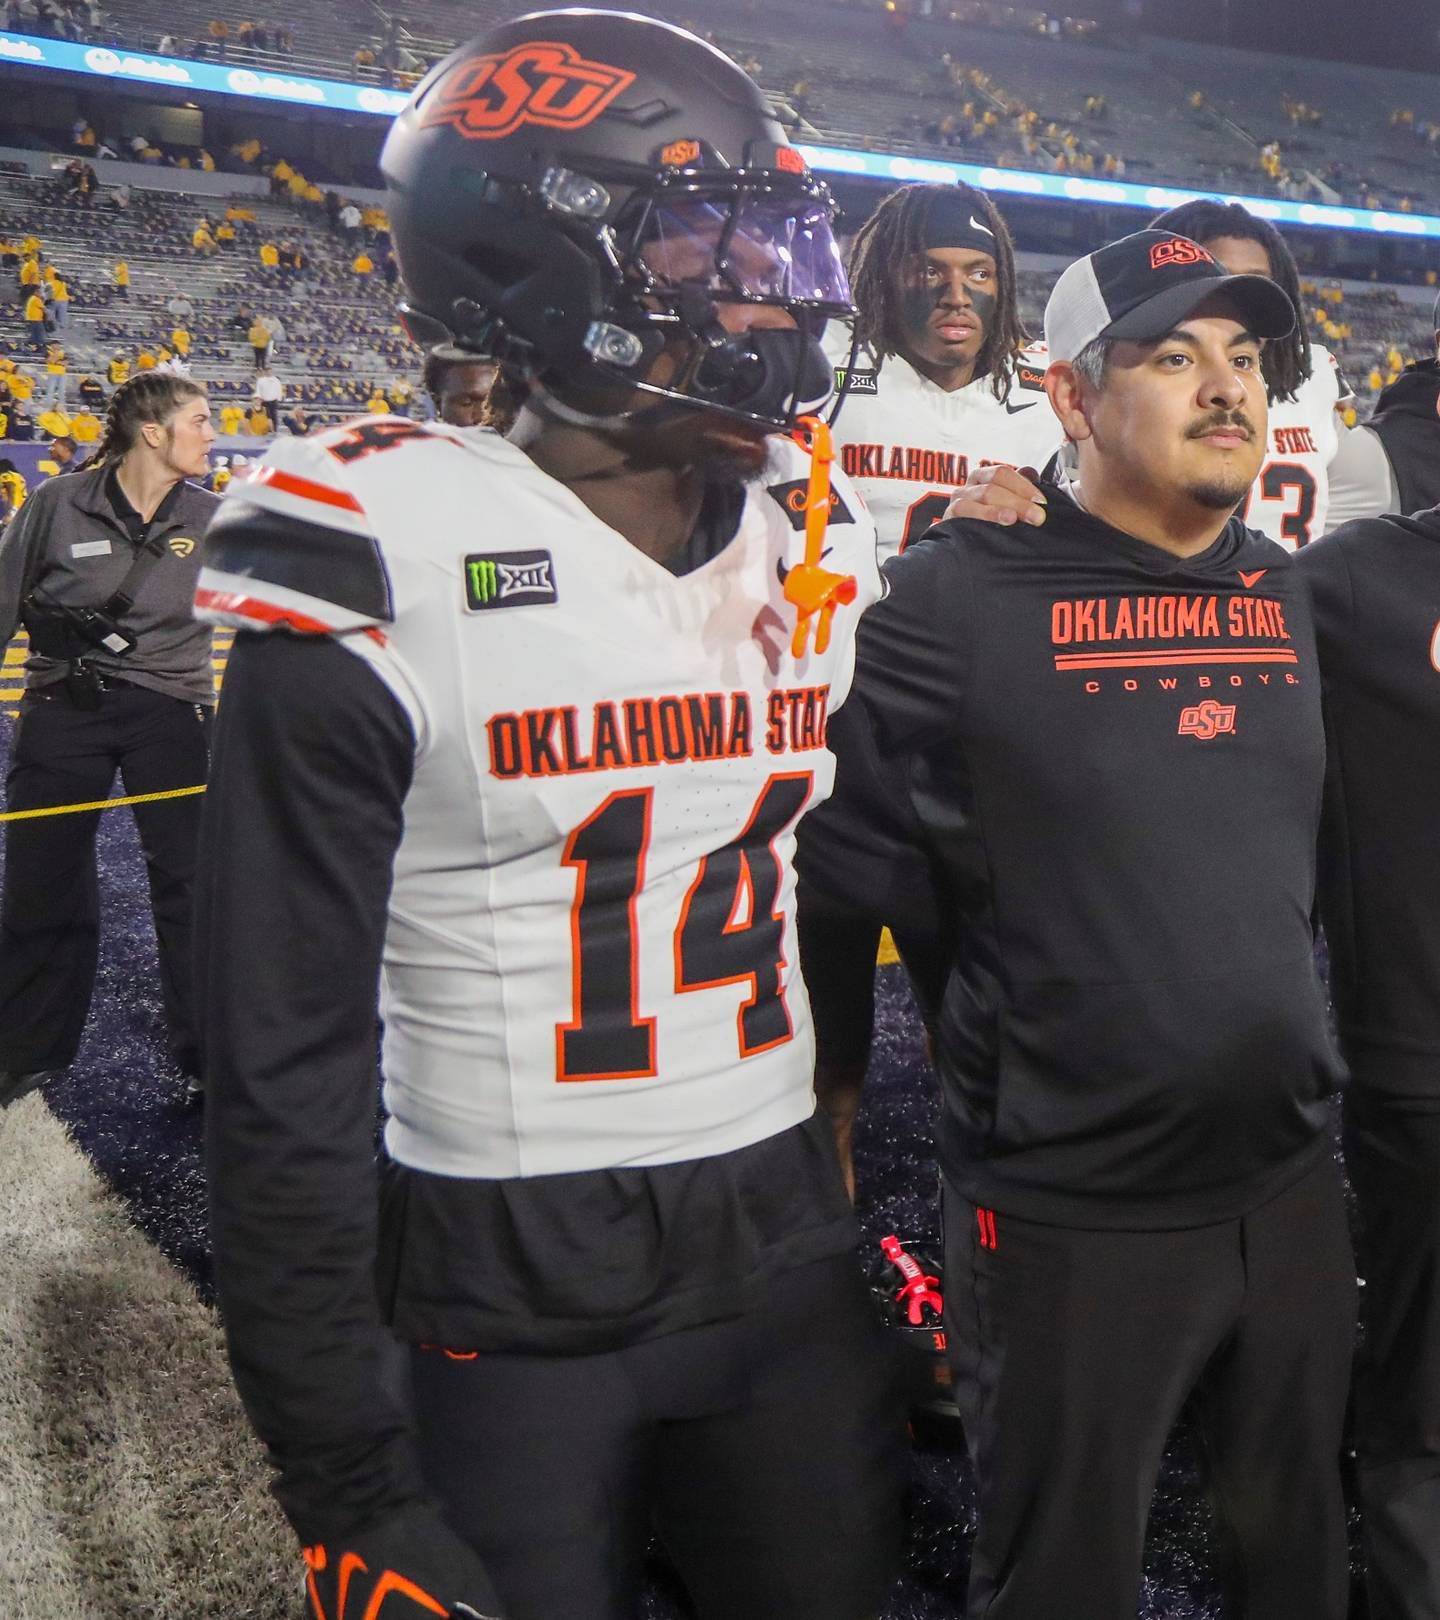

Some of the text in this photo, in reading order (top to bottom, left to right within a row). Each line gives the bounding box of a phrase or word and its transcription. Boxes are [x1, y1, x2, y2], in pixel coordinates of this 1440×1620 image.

[1273, 426, 1318, 455] STATE
[841, 443, 969, 487] OKLAHOMA
[1051, 596, 1220, 644] OKLAHOMA
[486, 683, 831, 779] OKLAHOMA STAT
[1178, 700, 1237, 740] OSU
[555, 769, 815, 1082] 14
